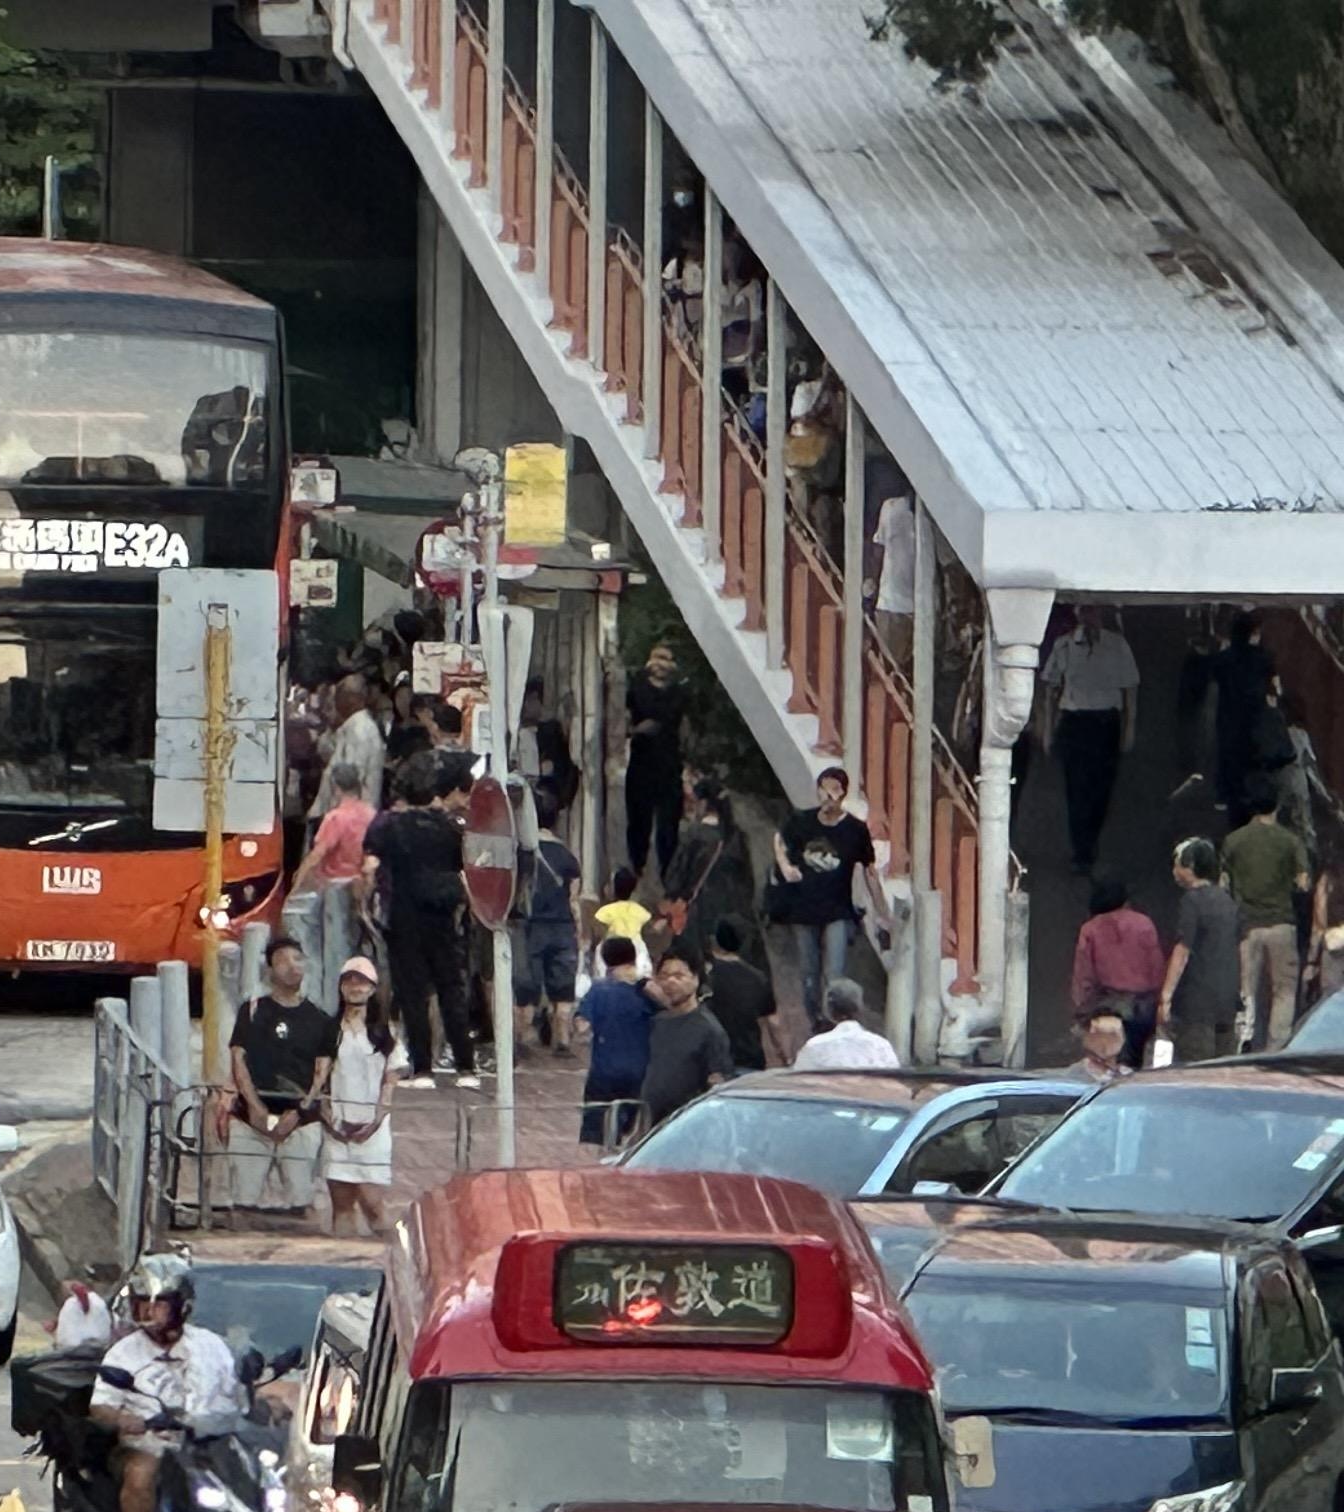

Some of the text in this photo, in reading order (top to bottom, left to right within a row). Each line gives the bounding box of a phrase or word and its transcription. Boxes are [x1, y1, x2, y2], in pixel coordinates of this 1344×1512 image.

[104, 522, 189, 568] E32A
[611, 1260, 783, 1318] 佐敦道
